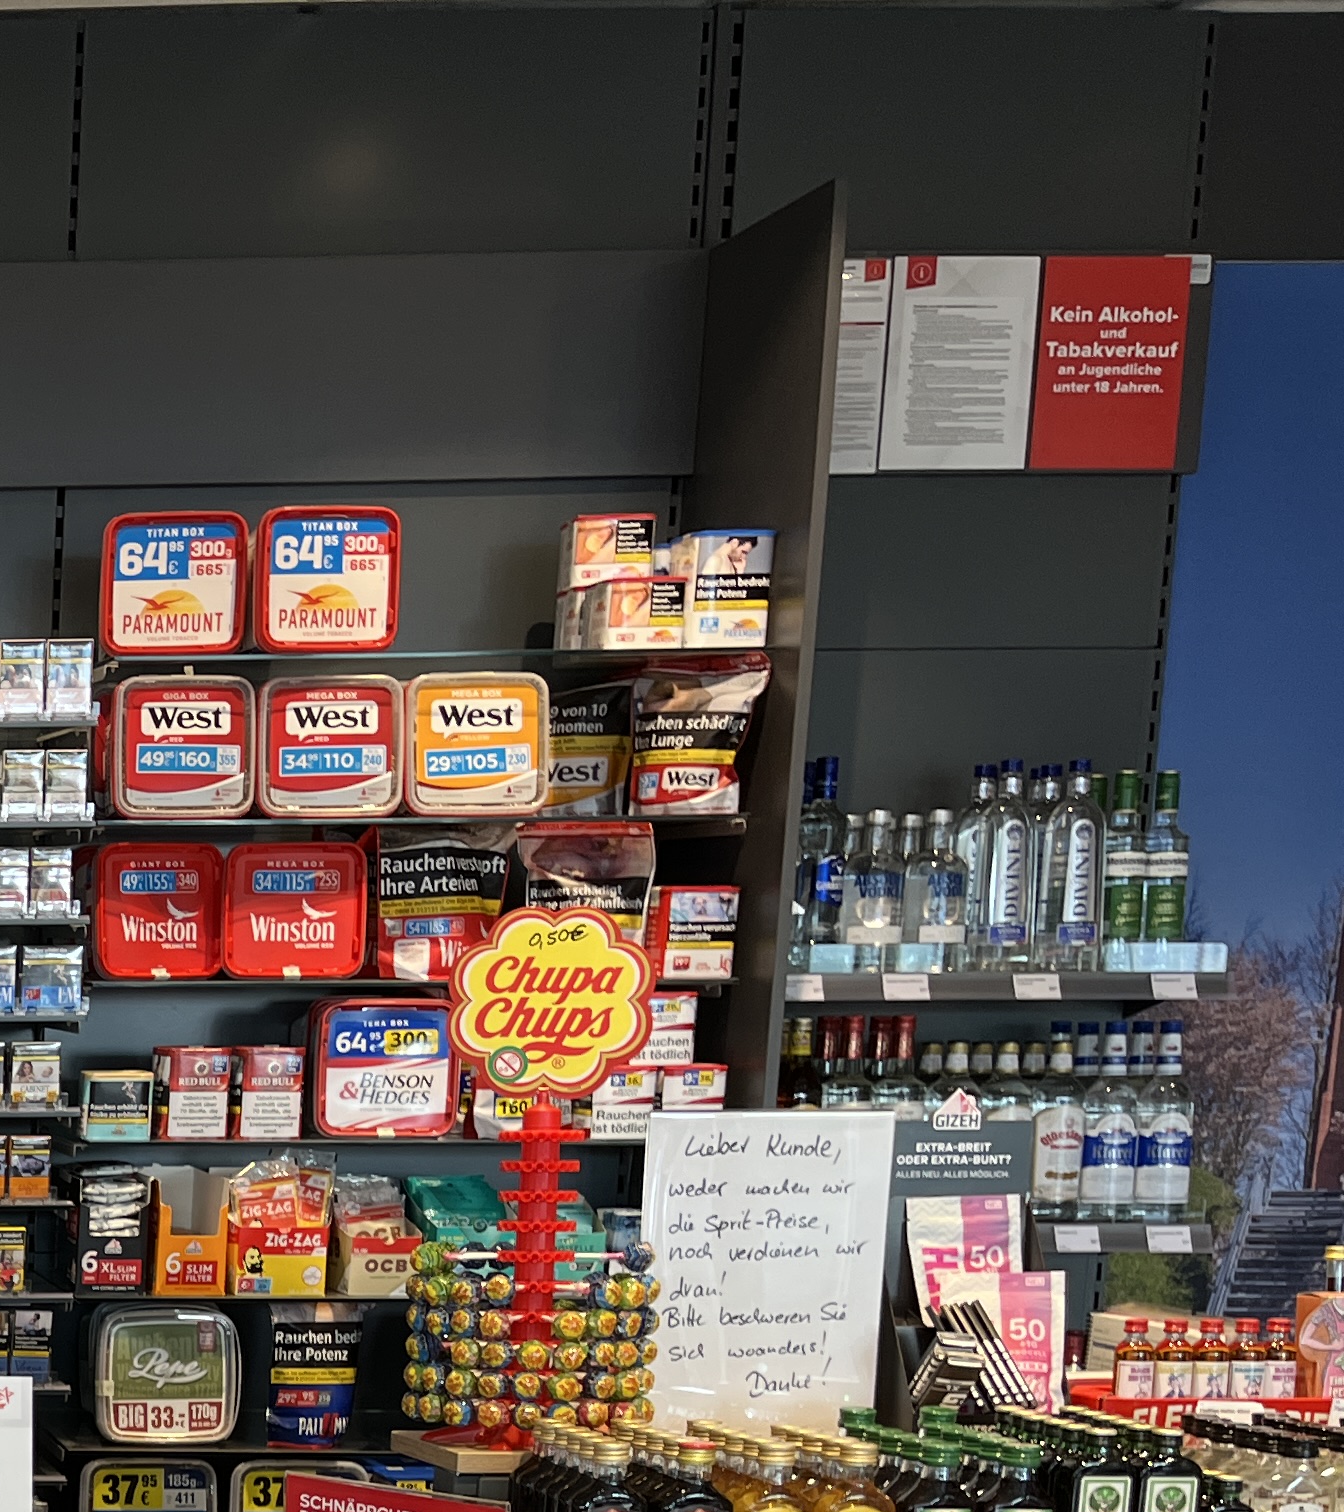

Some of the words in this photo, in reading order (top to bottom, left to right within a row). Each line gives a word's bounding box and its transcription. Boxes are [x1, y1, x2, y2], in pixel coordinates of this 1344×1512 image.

[1050, 306, 1093, 323] Kein
[1098, 305, 1179, 323] Alkohol-
[1100, 327, 1127, 339] und
[1046, 341, 1178, 358] Tabakverkauf
[1058, 365, 1075, 375] an
[1079, 364, 1162, 377] Jugendliche
[1053, 382, 1090, 393] unter
[1093, 381, 1109, 393] 18
[1113, 381, 1164, 394] Jahren.
[147, 528, 179, 538] TITAN
[182, 527, 205, 537] BOX
[122, 612, 224, 634] PARAMOUNT
[279, 608, 377, 630] PARAMOUNT
[306, 692, 331, 701] MEGA
[334, 692, 357, 700] BOX
[149, 706, 223, 729] West
[294, 706, 370, 728] West
[440, 704, 513, 727] West
[380, 855, 456, 876] Rauchen
[381, 877, 417, 896] Ihre
[420, 876, 479, 894] Arterien
[121, 913, 197, 942] Winston
[250, 912, 335, 942] Winston
[484, 954, 624, 997] Chupa
[359, 1072, 434, 1091] BENSON
[360, 1087, 430, 1106] HEDGES
[935, 1114, 979, 1129] GIZEH
[685, 1132, 750, 1157] Lieber
[766, 1133, 841, 1164] Kunde,
[916, 1142, 992, 1152] EXTRA-BREIT
[896, 1155, 929, 1165] ODER
[931, 1155, 1011, 1166] EXTRA-BUNT?
[669, 1179, 728, 1198] weder
[746, 1179, 810, 1195] machen
[823, 1179, 856, 1195] wir
[669, 1214, 694, 1234] die
[265, 1230, 324, 1249] ZIG-ZAG
[669, 1243, 712, 1261] noch
[729, 1241, 818, 1261] verdienen
[836, 1241, 868, 1257] wir
[365, 1258, 409, 1274] OCB
[670, 1271, 726, 1301] dran!
[662, 1304, 706, 1328] Bitte
[719, 1307, 810, 1326] beschweren
[821, 1303, 848, 1321] Sie
[275, 1347, 302, 1363] Ihre
[305, 1347, 349, 1364] Potenz
[669, 1344, 704, 1361] sich
[127, 1346, 208, 1388] Pepe
[118, 1406, 145, 1429] BIG
